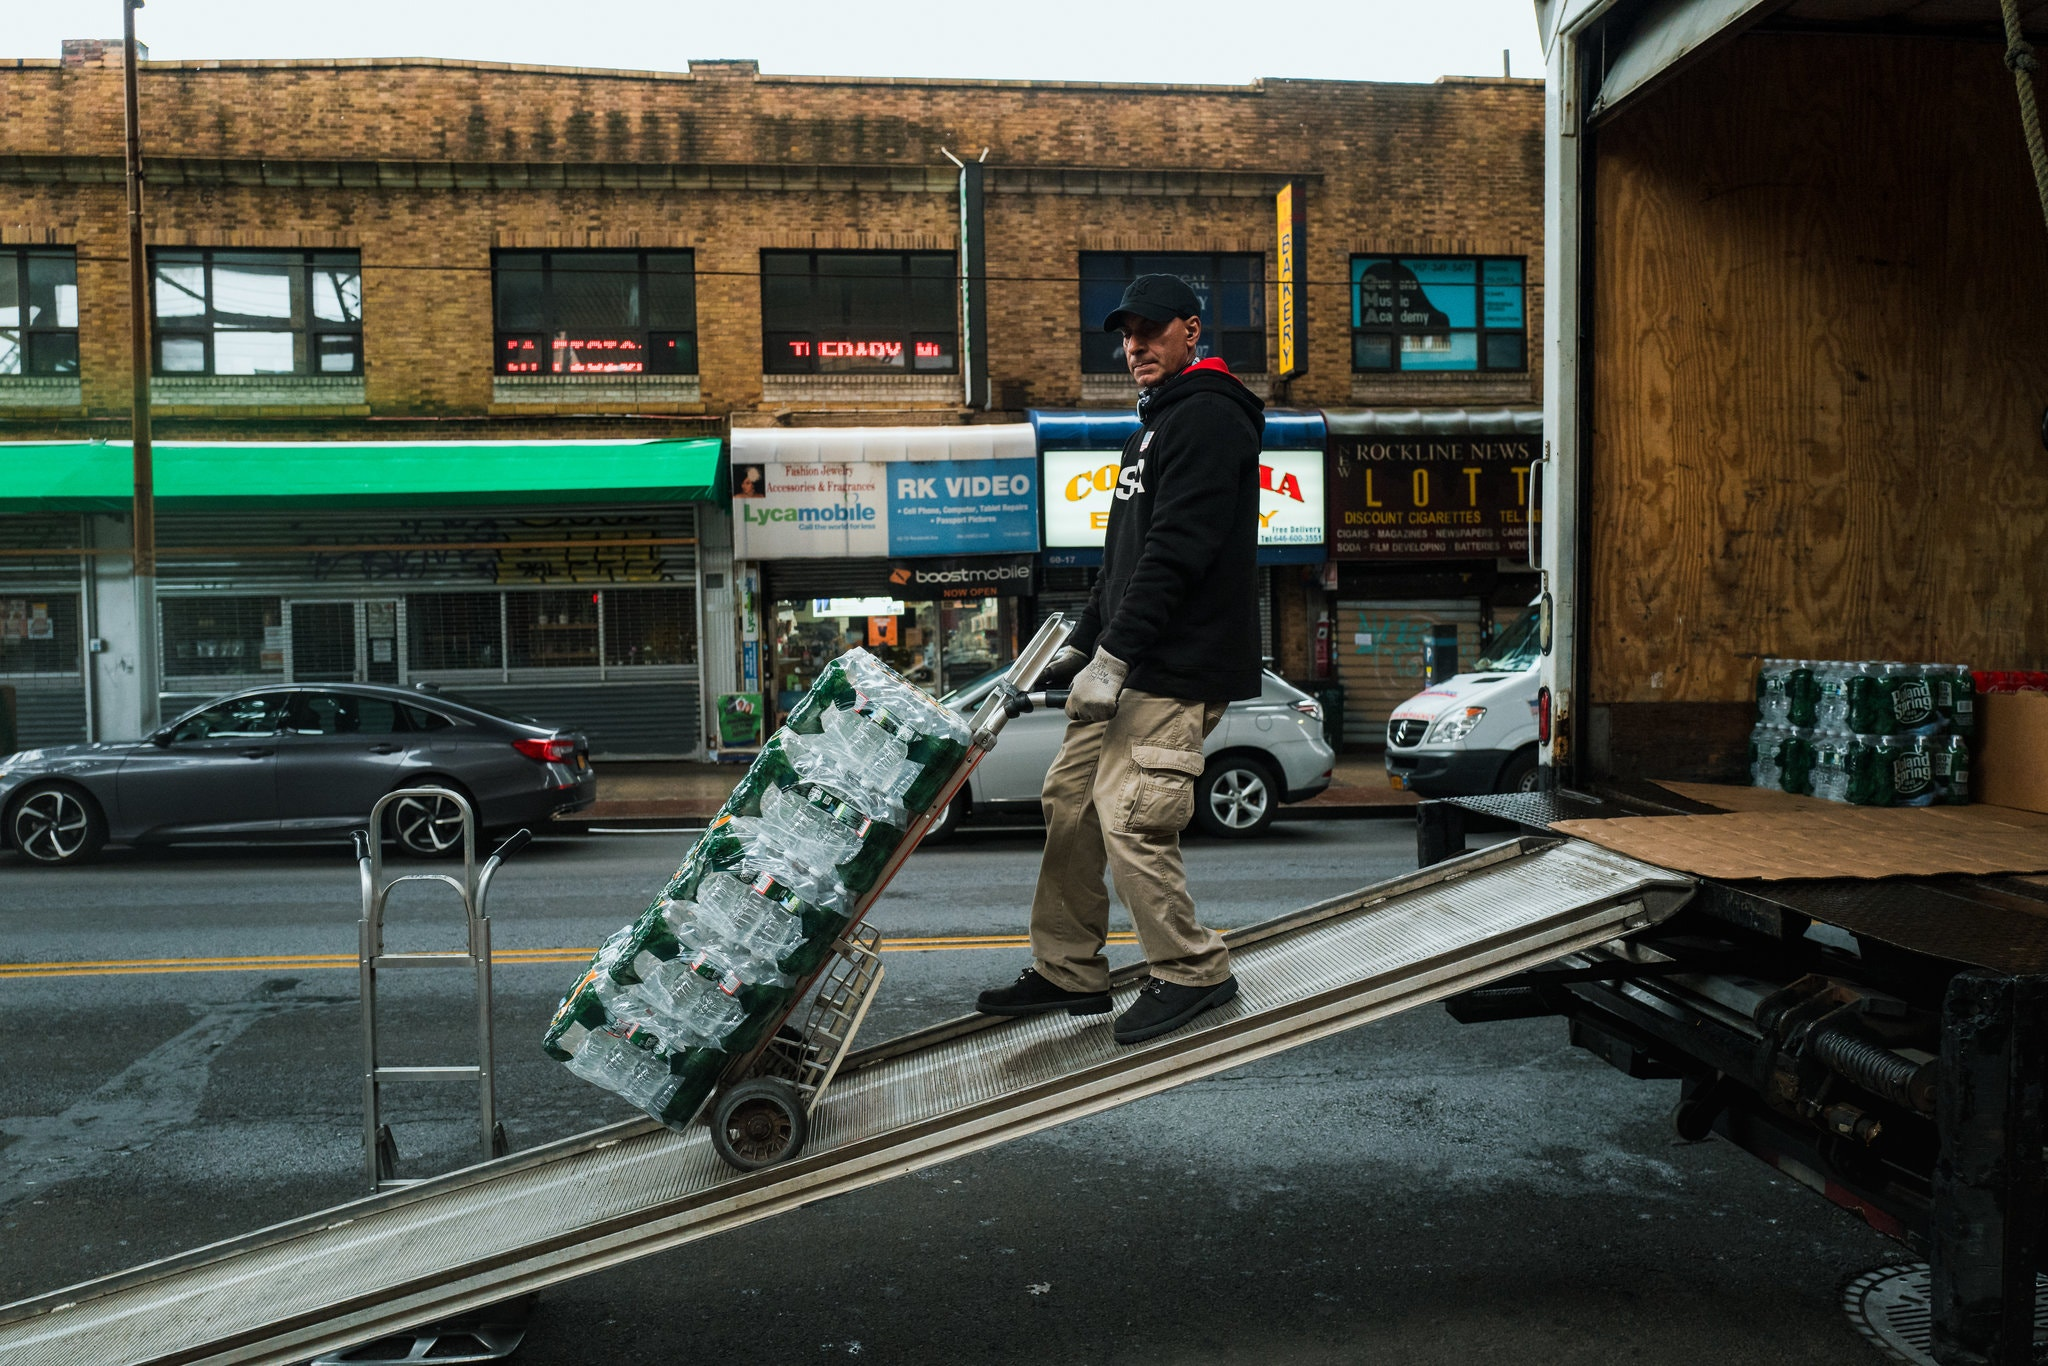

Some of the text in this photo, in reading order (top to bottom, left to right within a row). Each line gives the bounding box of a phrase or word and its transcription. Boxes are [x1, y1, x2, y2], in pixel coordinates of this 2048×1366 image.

[1281, 233, 1292, 366] BAKERY
[1356, 442, 1530, 461] ROCKLINE NEWS
[785, 465, 854, 477] Fashion Jewelry
[766, 481, 876, 493] Accessories & Fragrances
[897, 474, 1030, 499] RK VIDEO
[744, 503, 876, 525] Lycamobile
[980, 504, 1001, 513] Tablet
[1002, 503, 1029, 513] Repairs
[936, 515, 997, 525] Passport Pictures
[1344, 510, 1482, 525] DISCOUNT CIGARETTES
[828, 522, 849, 530] world
[850, 522, 860, 530] for
[861, 522, 876, 530] less
[1290, 526, 1321, 534] Delivery
[1337, 529, 1369, 539] CIGARS
[1377, 529, 1428, 539] MAGAZINES
[1435, 528, 1494, 539] NEWSPAPERS
[1337, 543, 1361, 552] SODA
[1369, 543, 1390, 552] FILM
[1392, 542, 1446, 553] DEVELOPING
[1454, 541, 1500, 551] BATTERIES
[915, 565, 1030, 584] boostmobile
[943, 587, 997, 598] NOW OPEN
[1891, 681, 1931, 705] Poland
[1894, 696, 1932, 721] Spring
[1893, 751, 1931, 774] Poland
[1894, 767, 1931, 790] Spring
